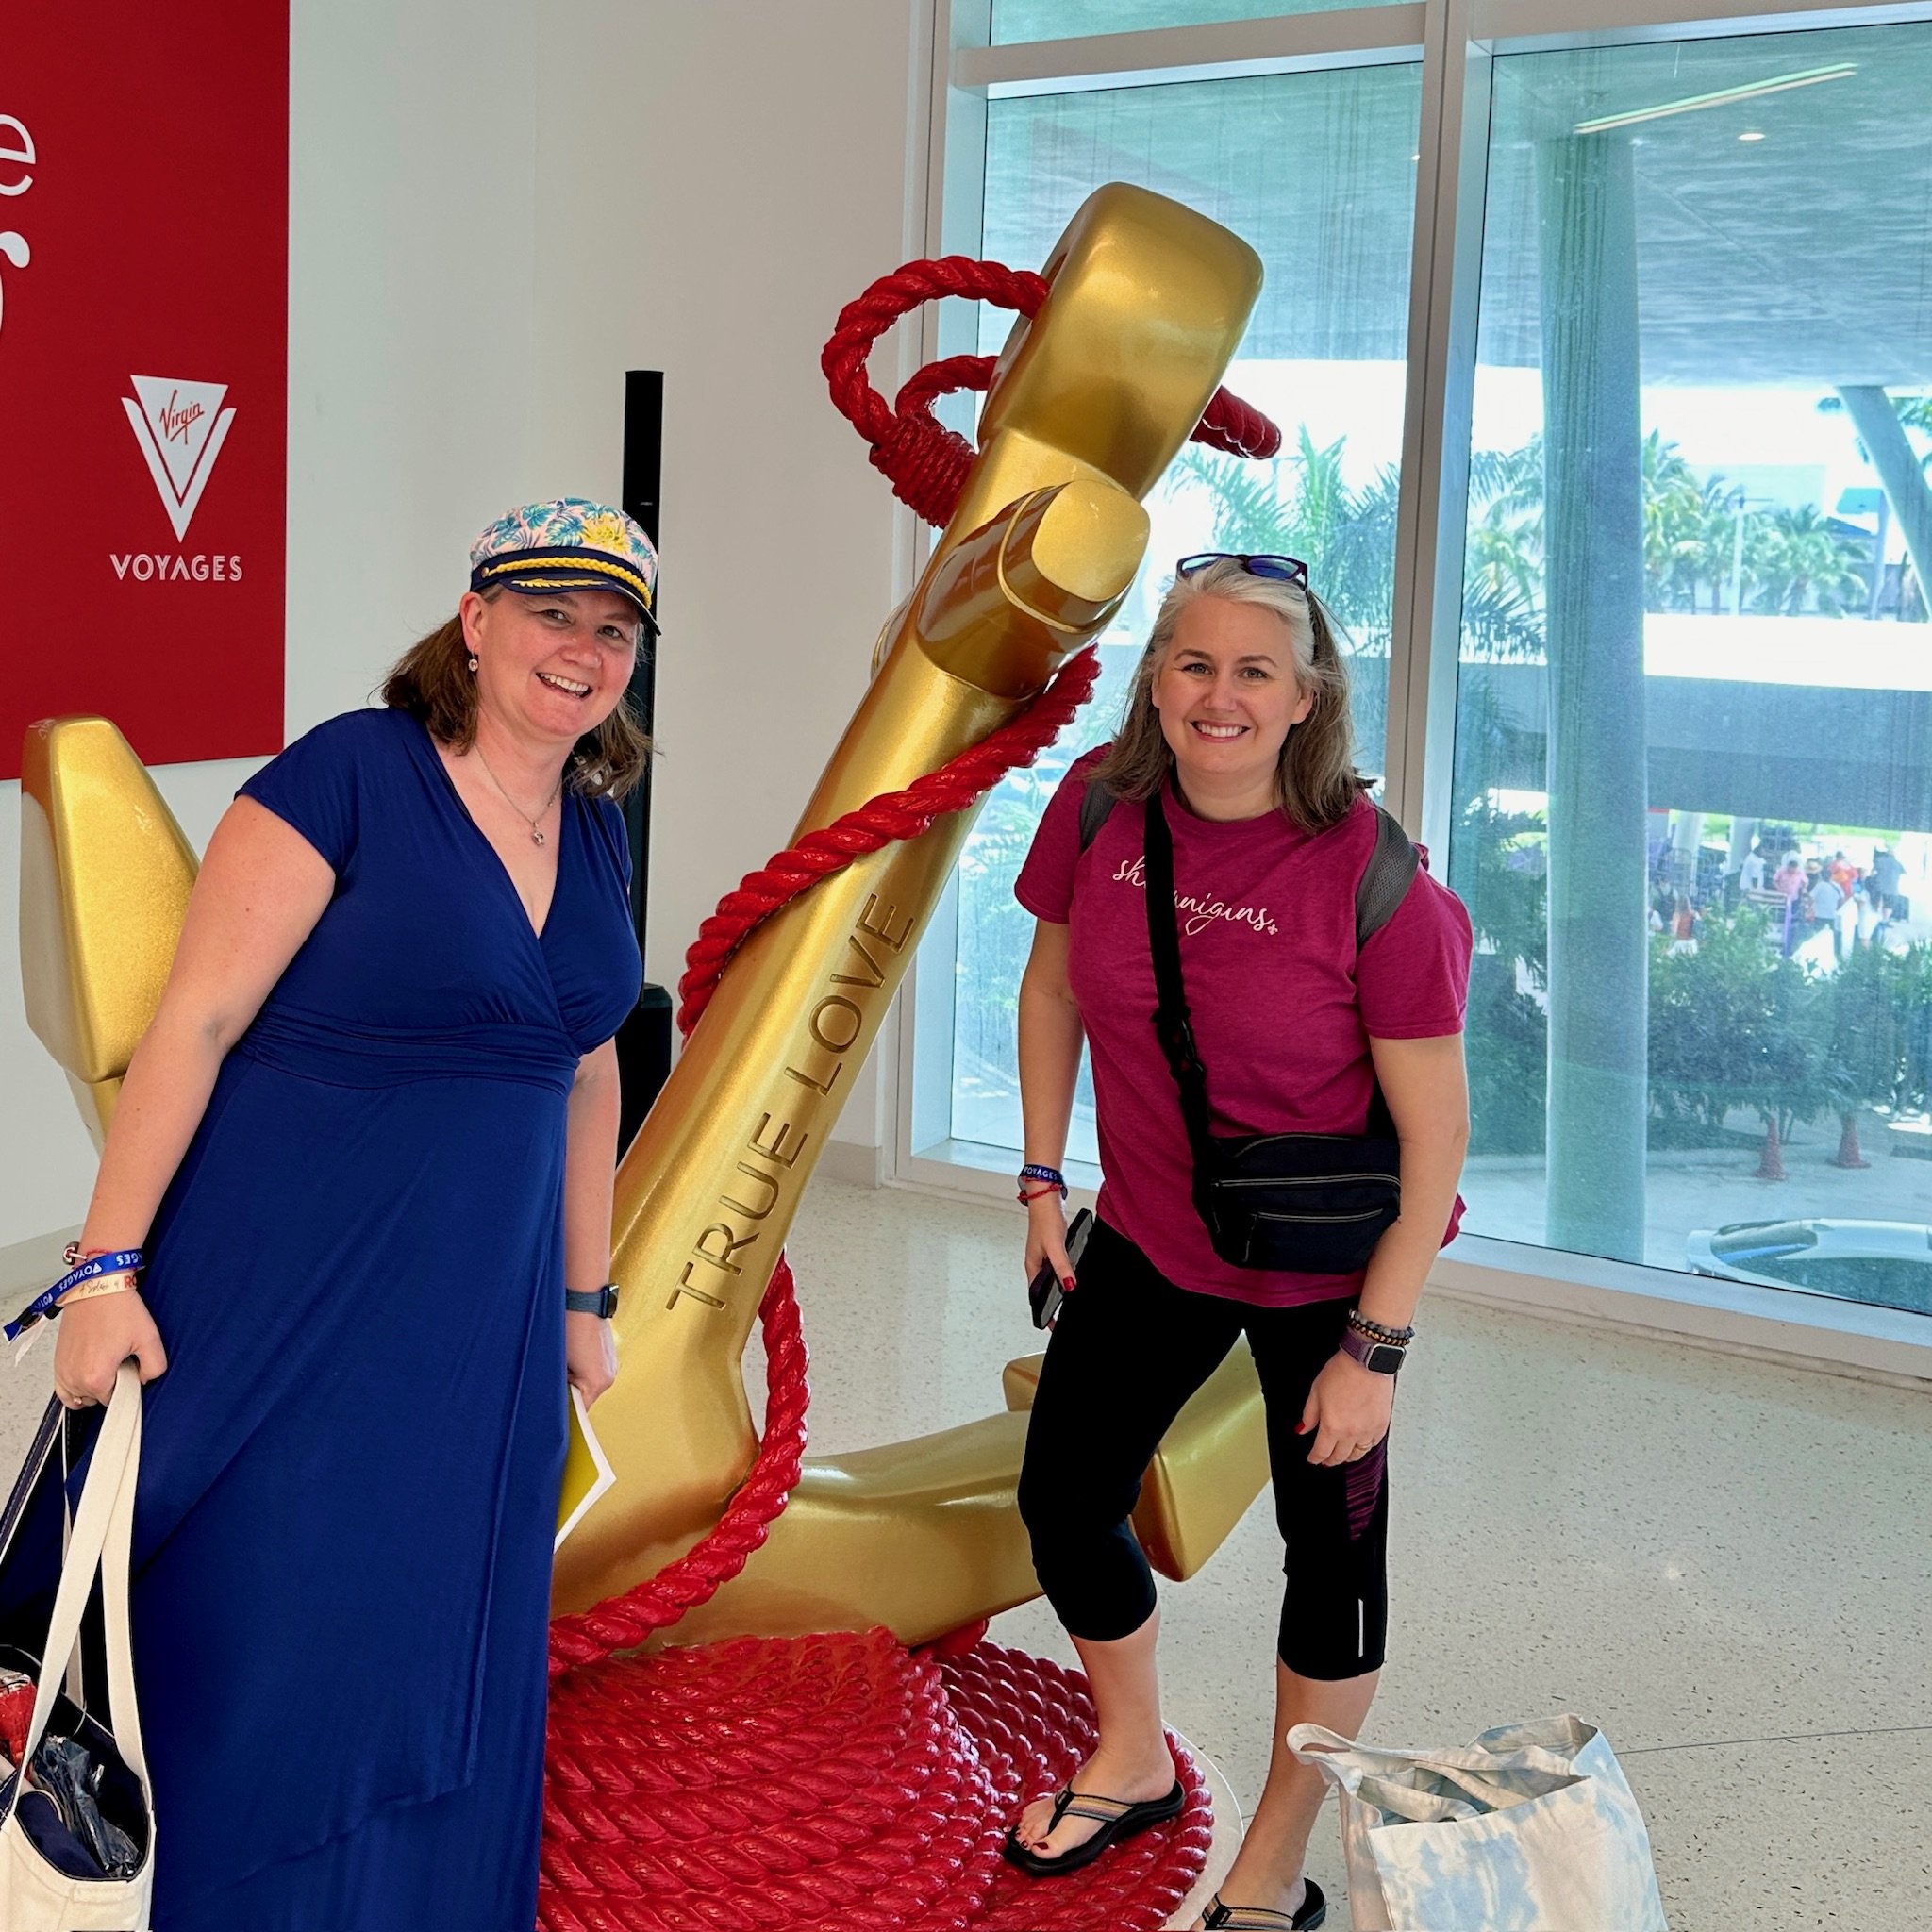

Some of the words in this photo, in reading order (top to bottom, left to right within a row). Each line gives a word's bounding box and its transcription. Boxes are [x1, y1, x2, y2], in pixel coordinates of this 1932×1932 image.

[159, 389, 205, 445] Virgin
[109, 553, 243, 581] VOYAGES
[665, 1112, 808, 1310] TRUE
[784, 892, 915, 1097] LOVE
[1023, 1166, 1058, 1180] VOYAGES
[58, 1262, 102, 1292] VOYAGES
